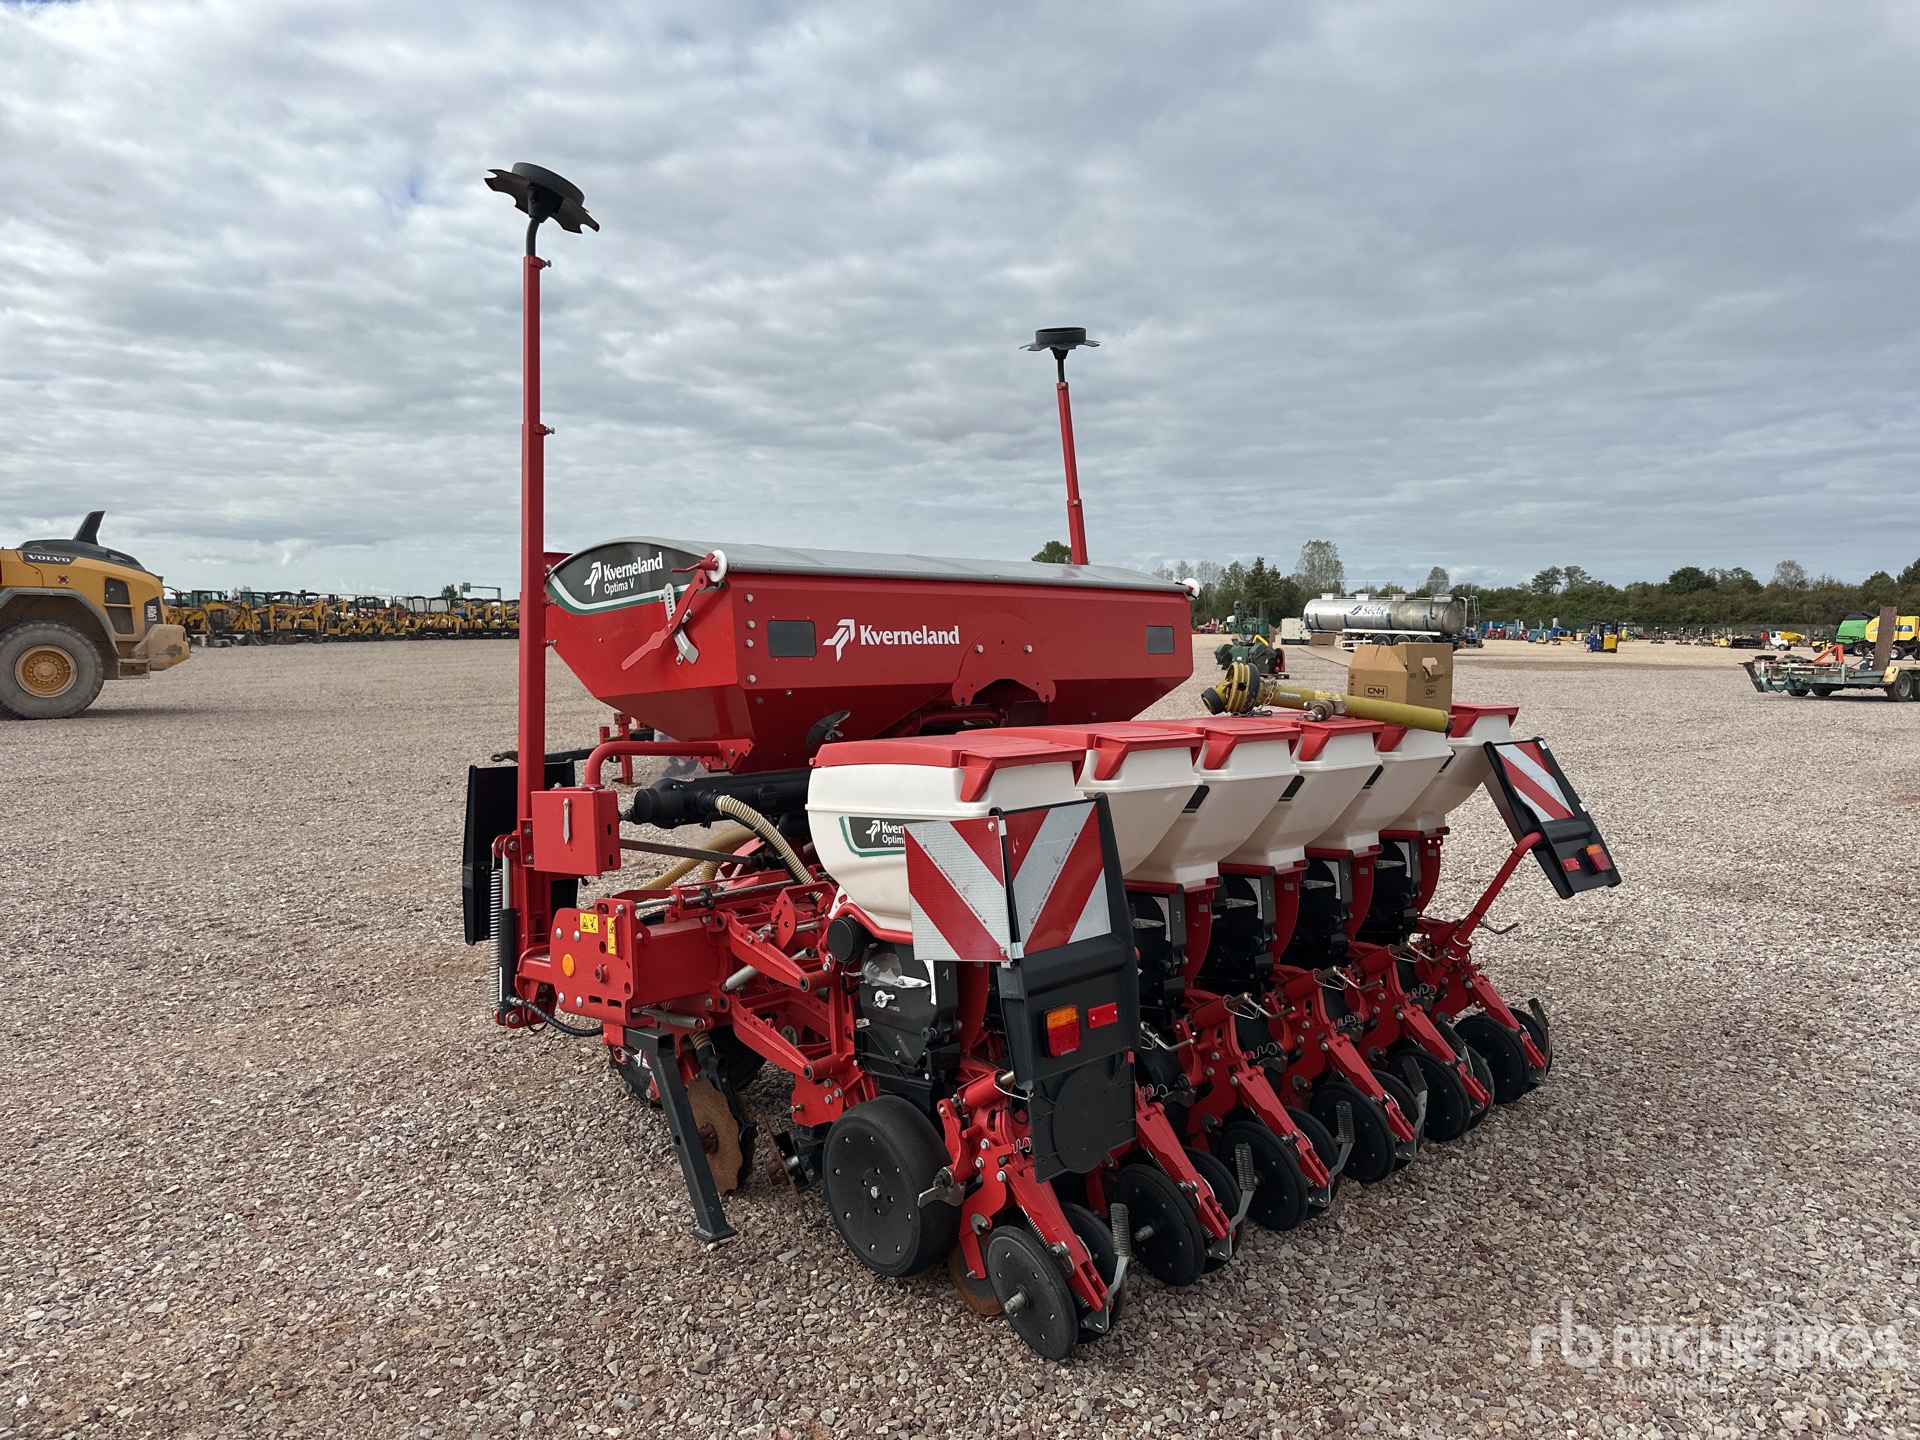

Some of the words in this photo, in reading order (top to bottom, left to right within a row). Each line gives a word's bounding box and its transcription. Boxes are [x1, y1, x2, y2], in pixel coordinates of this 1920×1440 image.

[28, 554, 71, 563] VOLVO
[603, 551, 663, 582] Kverneland
[604, 581, 629, 596] Optima
[629, 577, 635, 589] V
[860, 625, 960, 645] Kverneland
[1367, 687, 1384, 695] CNH
[1176, 911, 1181, 922] 3
[942, 968, 950, 981] 1
